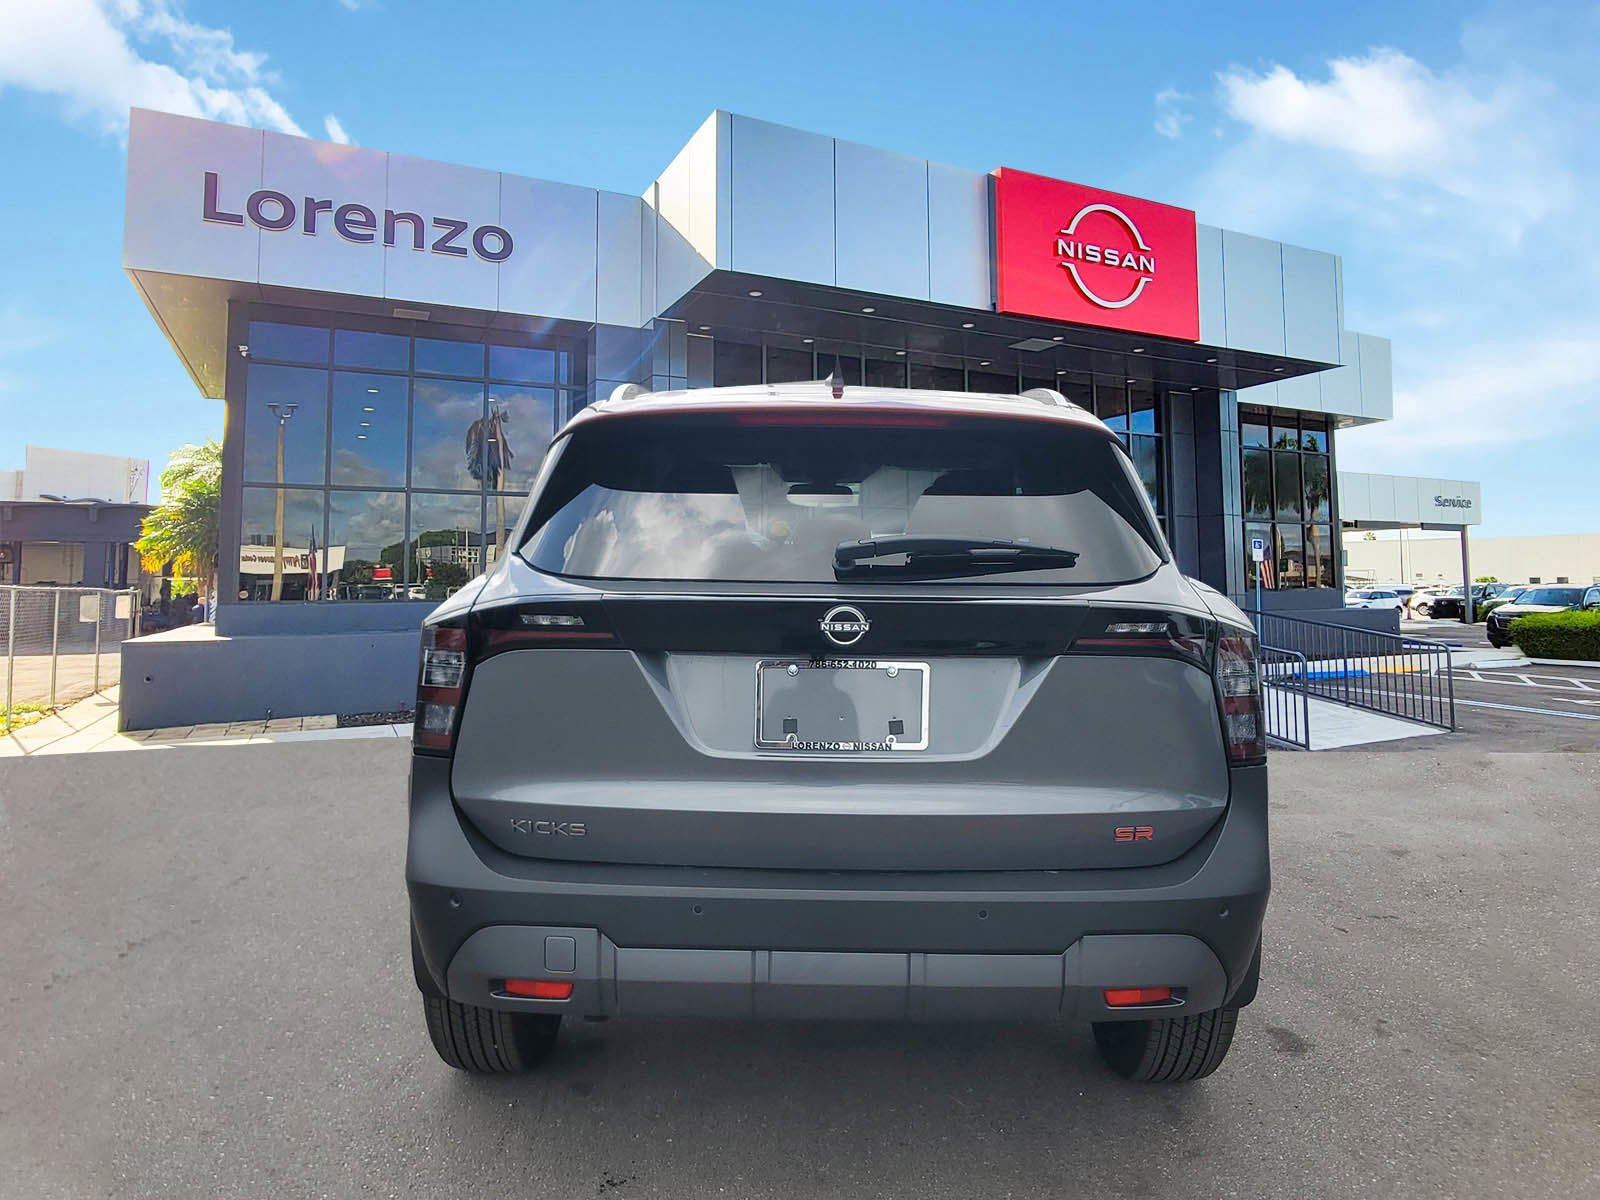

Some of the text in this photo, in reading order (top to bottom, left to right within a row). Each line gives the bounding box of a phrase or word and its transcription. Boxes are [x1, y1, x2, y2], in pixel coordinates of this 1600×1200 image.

[202, 171, 514, 263] Lorenzo
[1057, 238, 1156, 273] NISSAN
[1434, 495, 1472, 509] Service
[821, 623, 869, 631] NISSAN
[792, 741, 892, 751] LORENZO NISSAN
[510, 818, 587, 837] KICKS
[1114, 825, 1153, 842] SR
